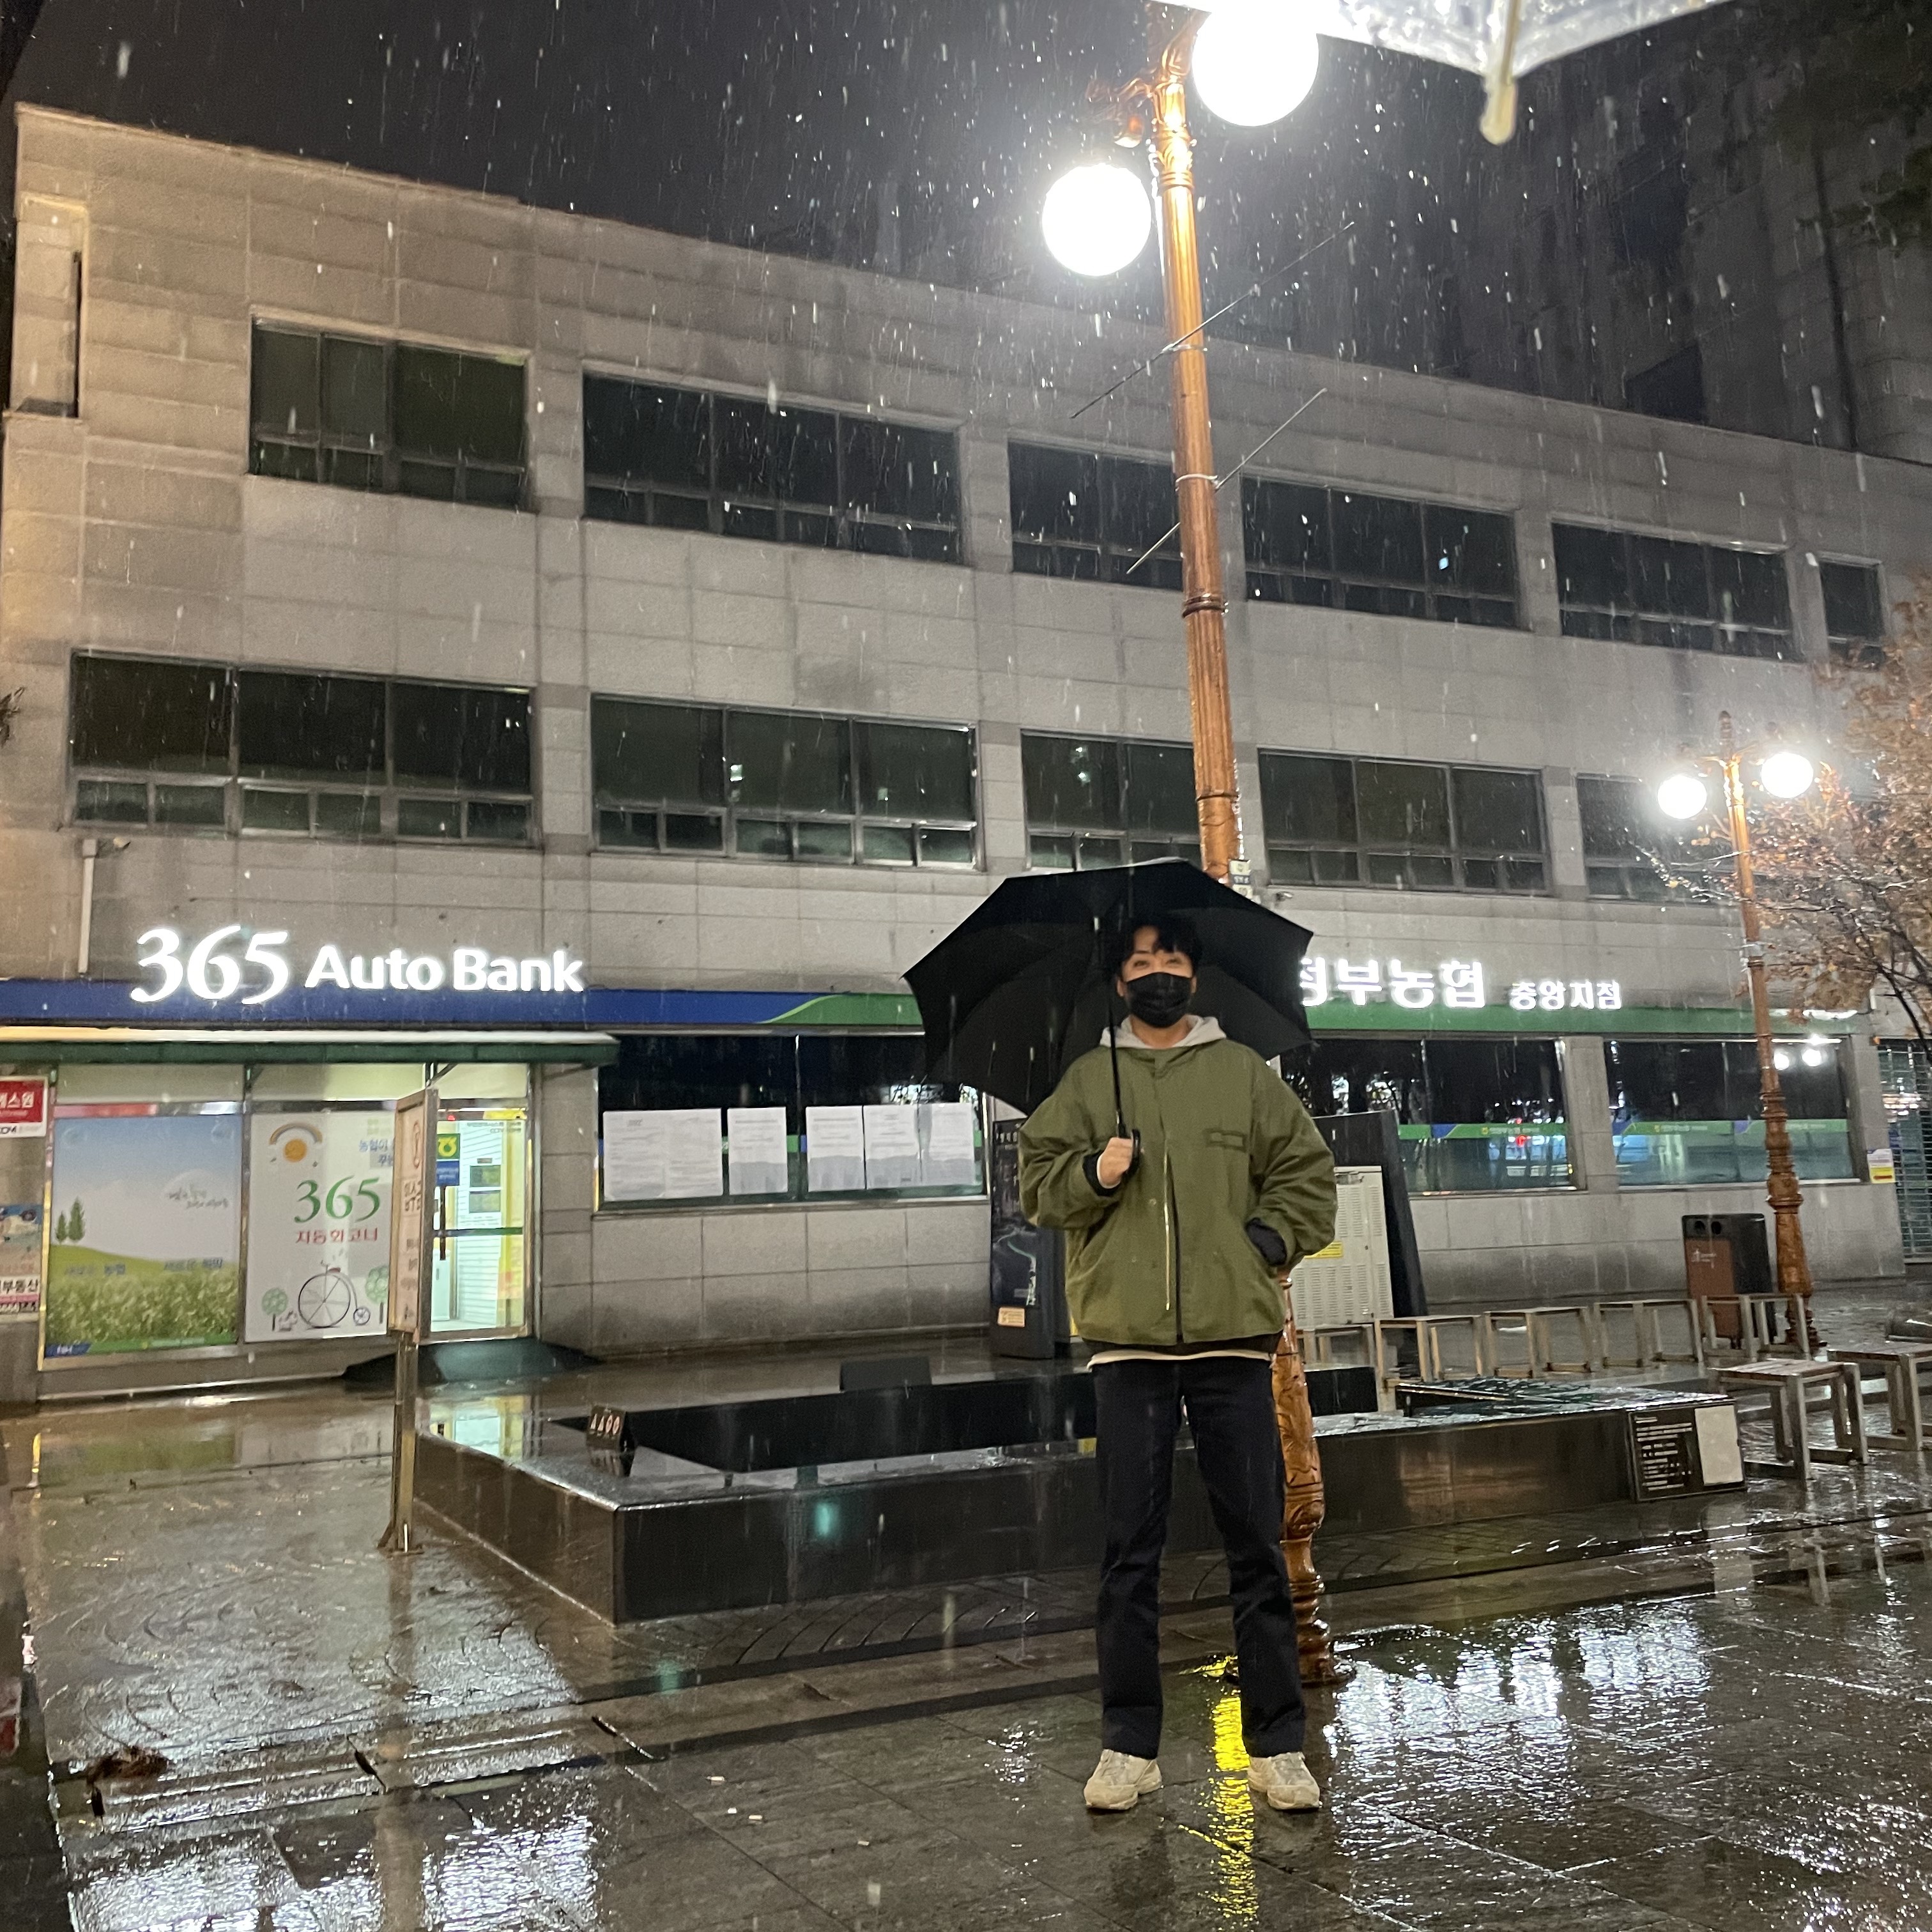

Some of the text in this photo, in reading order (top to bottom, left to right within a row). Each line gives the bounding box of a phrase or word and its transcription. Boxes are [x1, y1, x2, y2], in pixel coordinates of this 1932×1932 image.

[130, 924, 585, 1006] 365 Auto Bank
[1510, 979, 1623, 1011] 중앙지점
[294, 1175, 381, 1224] 365
[0, 1279, 39, 1294] 부동산
